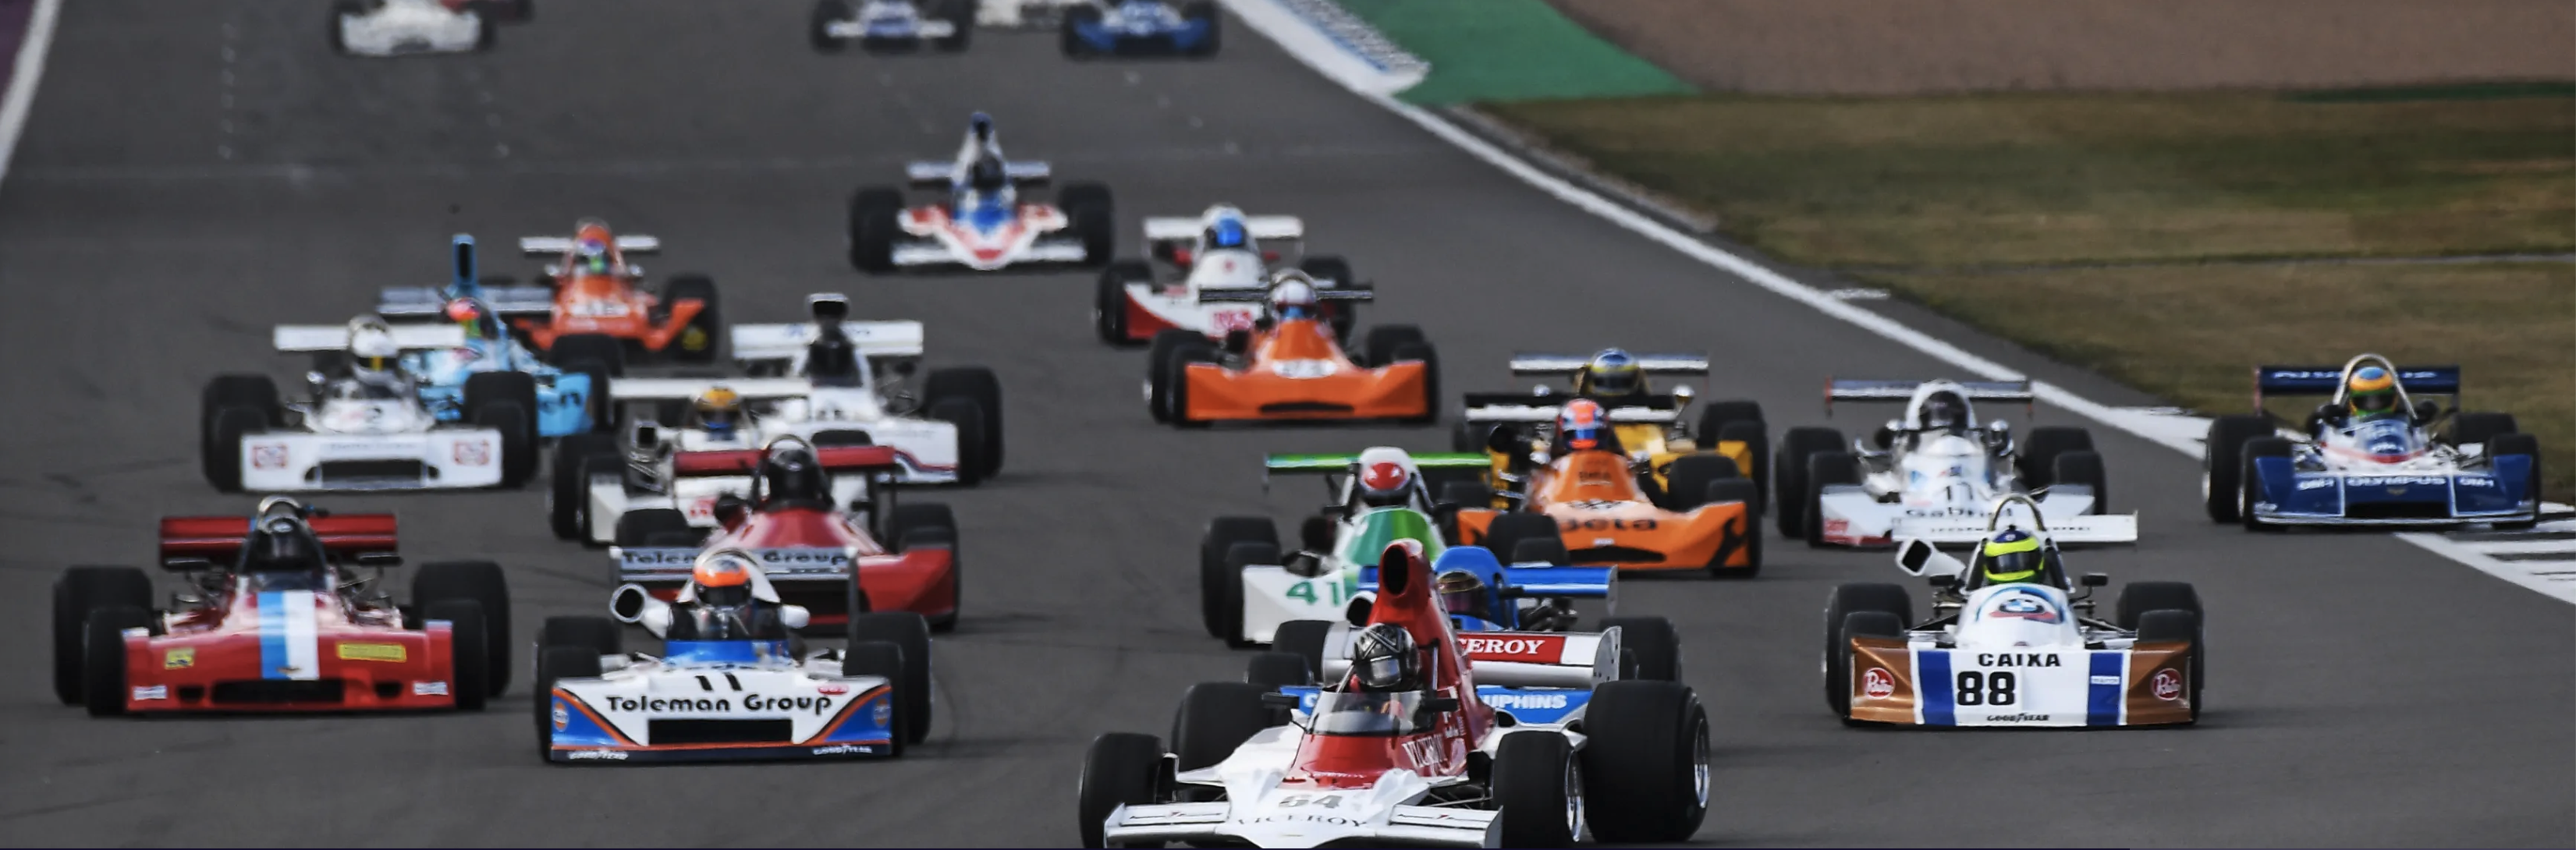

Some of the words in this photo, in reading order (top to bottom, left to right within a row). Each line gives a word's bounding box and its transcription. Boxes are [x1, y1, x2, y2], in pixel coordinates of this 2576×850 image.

[2346, 476, 2446, 487] OLYMPUS
[623, 551, 697, 563] Tolem
[764, 551, 847, 565] Group
[1285, 581, 1339, 606] 41
[1457, 638, 1545, 654] CEROY
[1978, 653, 2061, 667] CAIXA
[695, 672, 743, 691] 11
[1957, 671, 2015, 706] 88
[606, 696, 731, 711] Toleman
[743, 694, 832, 715] Group
[1480, 694, 1567, 709] UPHINS
[1986, 712, 2050, 723] GOODYEAR
[1279, 795, 1343, 809] 64
